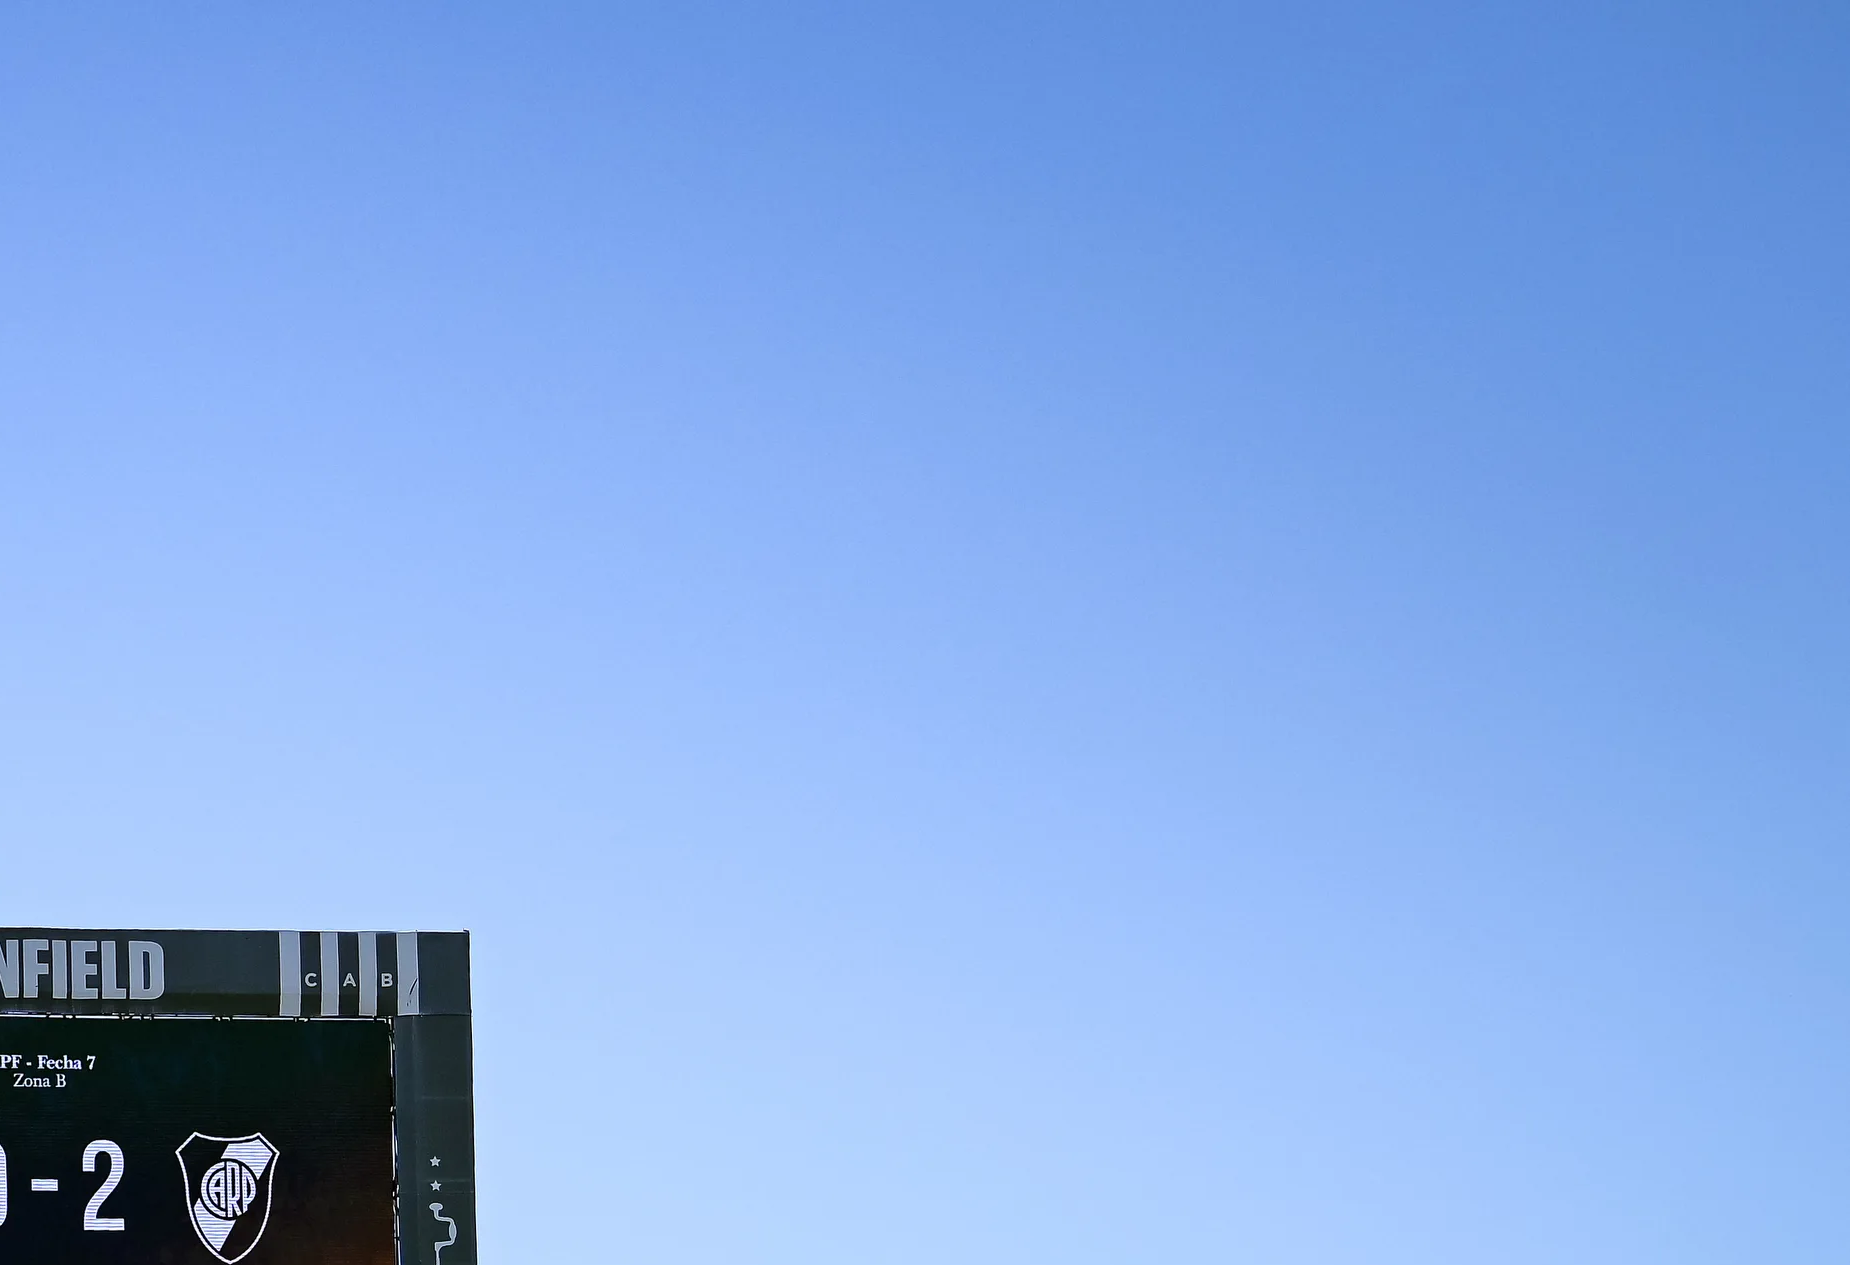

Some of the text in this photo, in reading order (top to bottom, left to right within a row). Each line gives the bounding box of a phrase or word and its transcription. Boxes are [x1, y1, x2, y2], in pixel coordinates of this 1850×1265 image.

[305, 972, 394, 988] C A B
[37, 1054, 83, 1070] Fecha
[86, 1055, 96, 1070] 7
[13, 1073, 67, 1088] Zona B
[82, 1139, 125, 1231] 2
[201, 1161, 256, 1218] CARP
